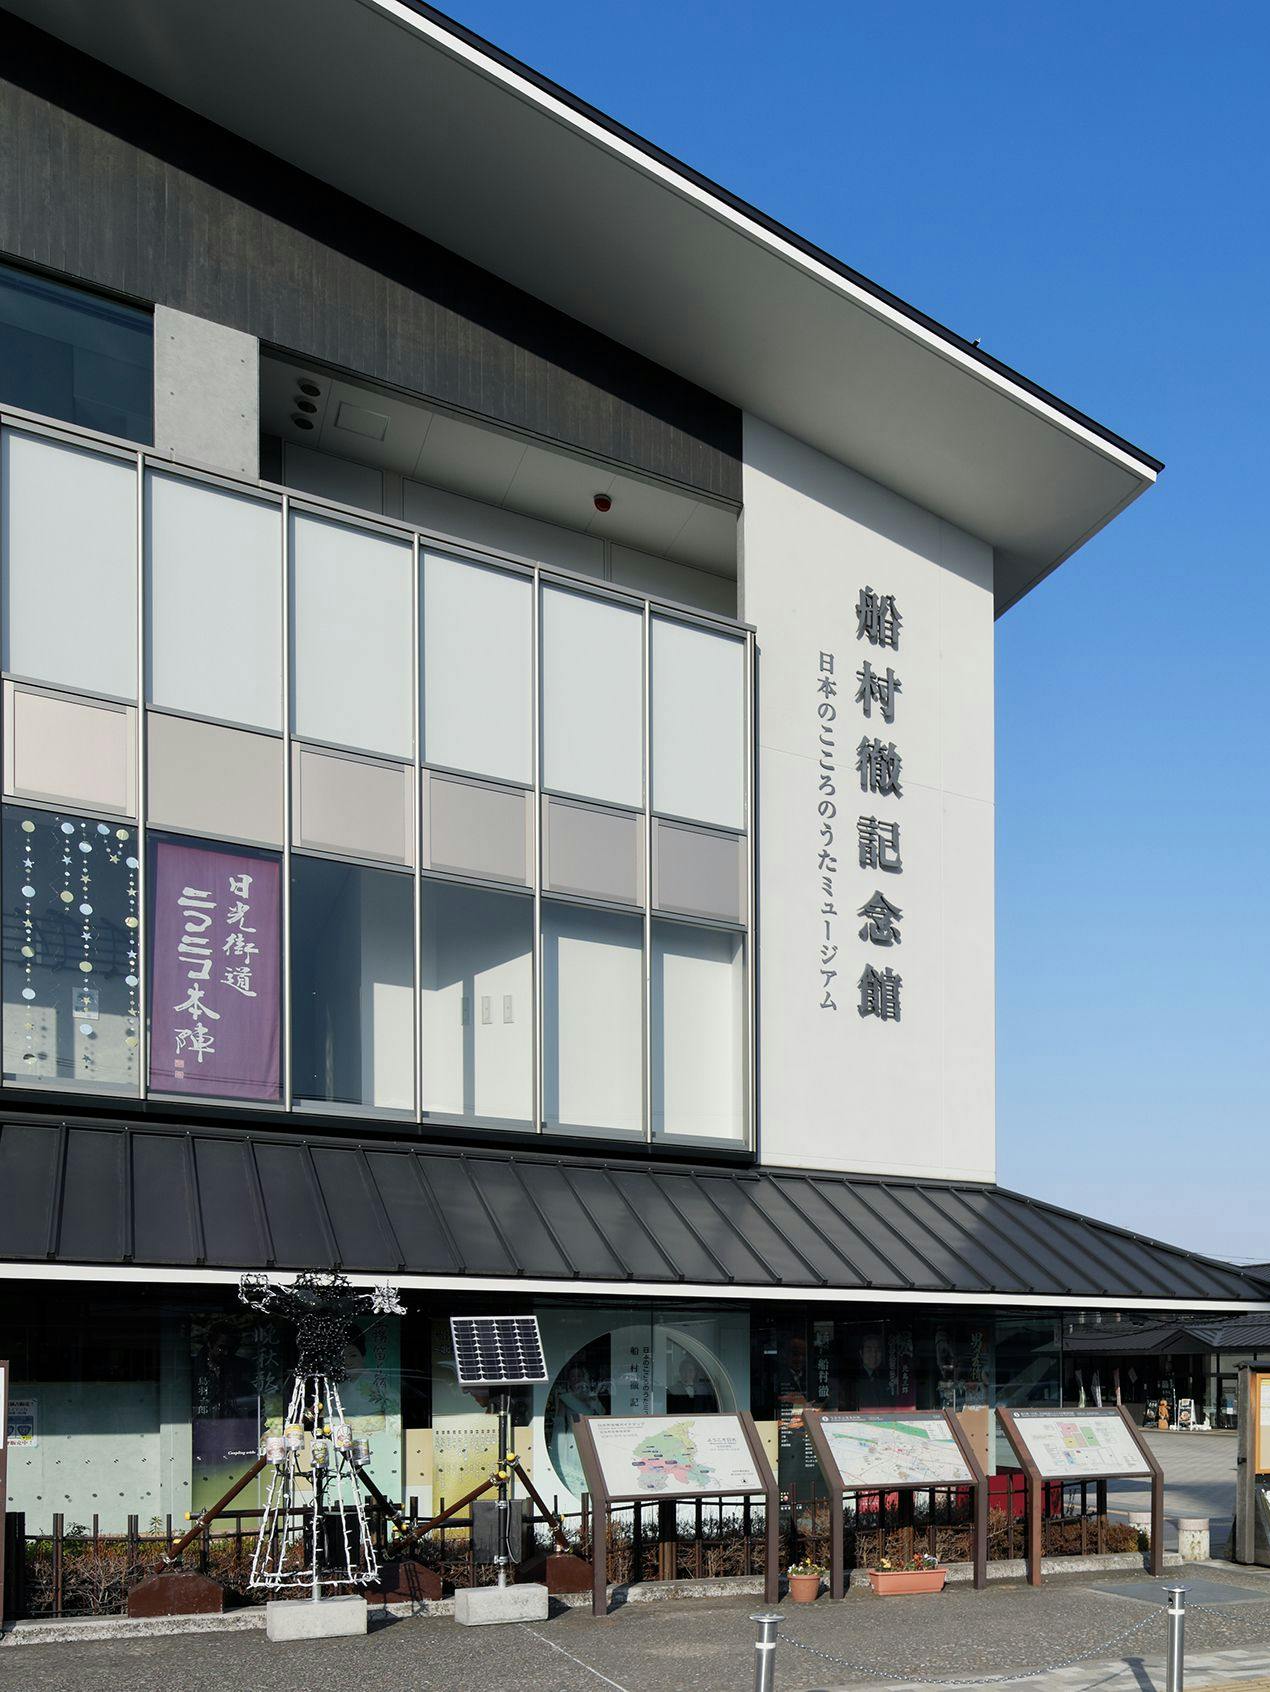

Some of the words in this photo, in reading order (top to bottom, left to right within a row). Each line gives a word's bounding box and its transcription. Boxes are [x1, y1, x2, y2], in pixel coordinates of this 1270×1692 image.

[220, 873, 260, 998] 日光街道
[817, 650, 838, 1011] 日本のこころのうたミュージアム
[855, 585, 903, 1023] 船村徹記念館
[173, 886, 221, 1063] ニコニコ本陣
